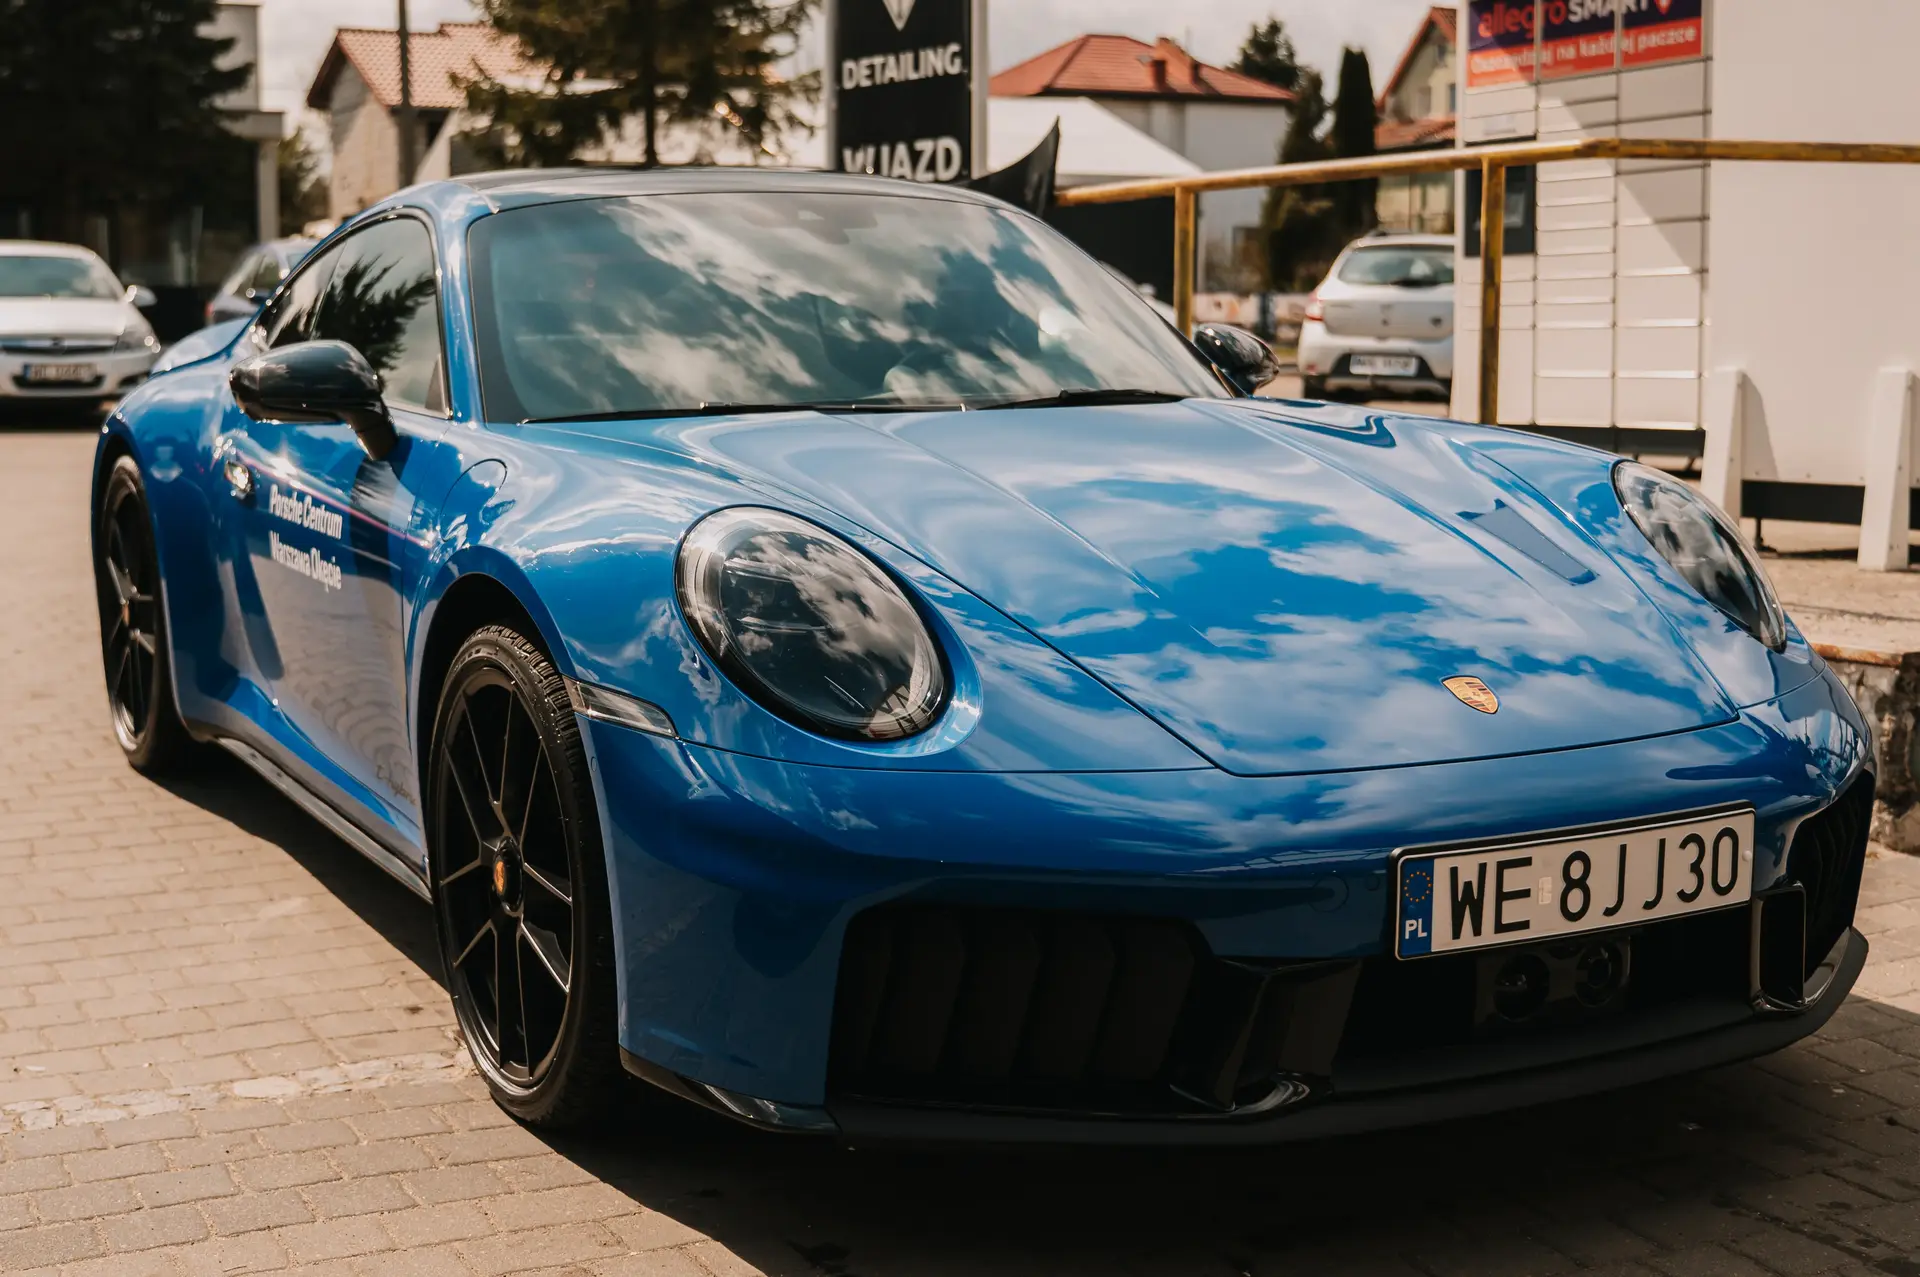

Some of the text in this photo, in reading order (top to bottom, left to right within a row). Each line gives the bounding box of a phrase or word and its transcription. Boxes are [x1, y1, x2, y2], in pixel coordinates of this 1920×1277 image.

[1478, 0, 1567, 39] allegro
[842, 42, 962, 90] DETAILING
[268, 484, 343, 540] Porsche Centrum
[268, 530, 311, 577] Warszawa
[1449, 826, 1741, 941] WE 8JJ30
[1404, 918, 1428, 940] PL
